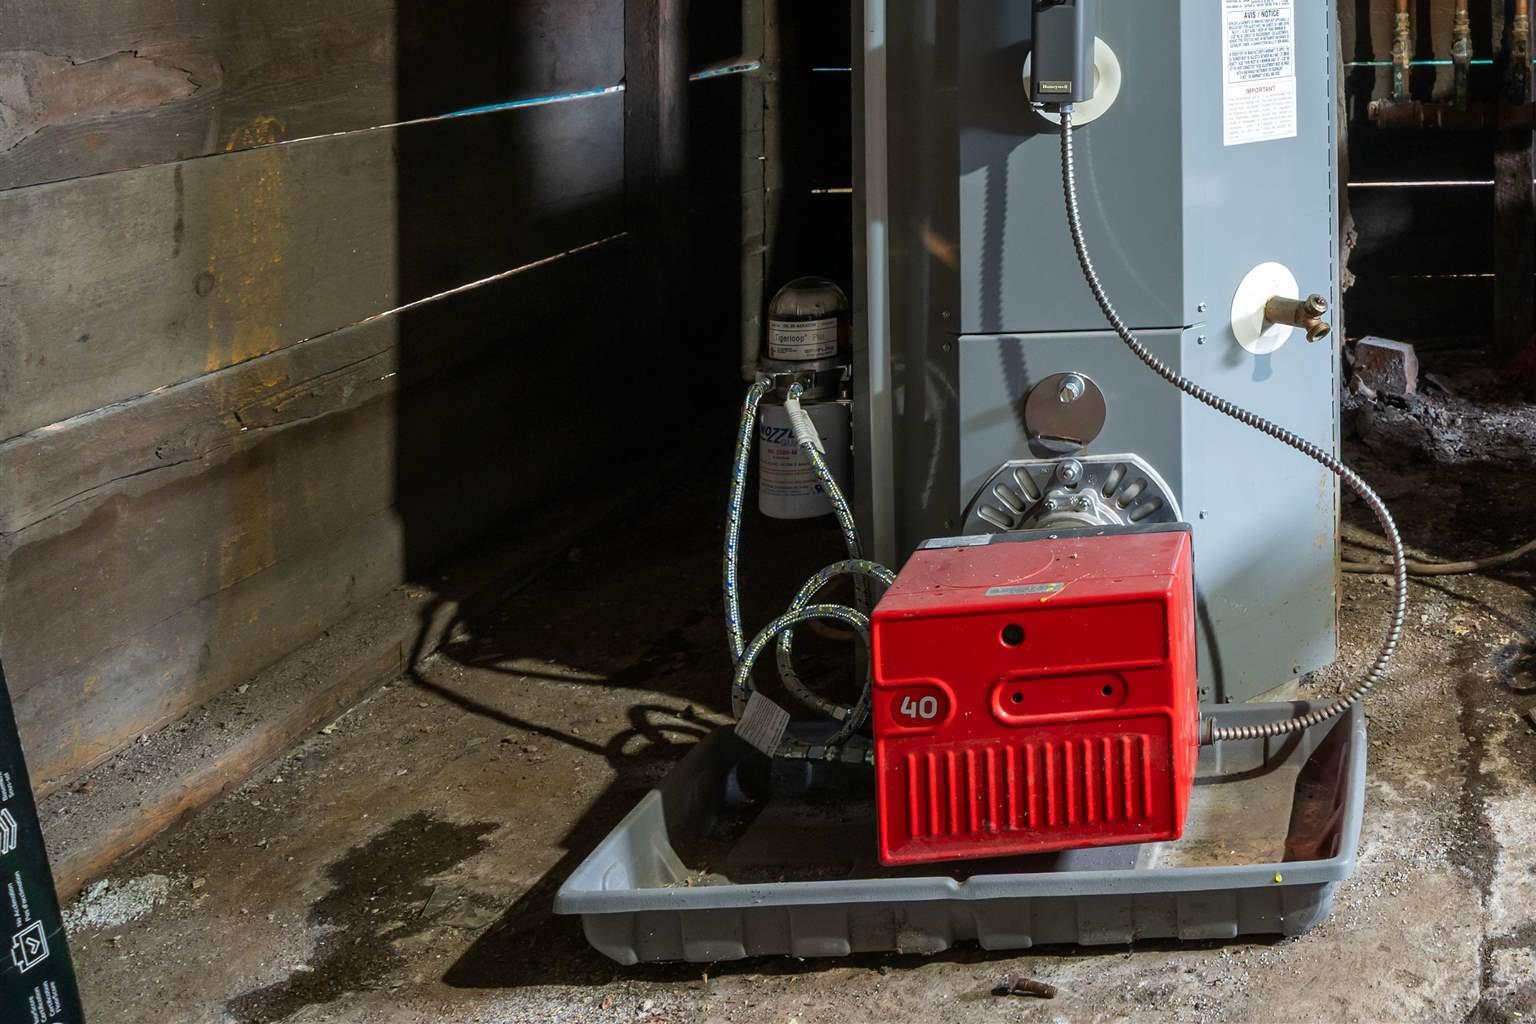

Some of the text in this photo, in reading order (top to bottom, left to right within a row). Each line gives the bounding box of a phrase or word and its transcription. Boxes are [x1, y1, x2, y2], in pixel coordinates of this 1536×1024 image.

[1261, 9, 1280, 17] NOTICE
[1245, 85, 1275, 94] IMPORTANT
[901, 696, 937, 718] 40
